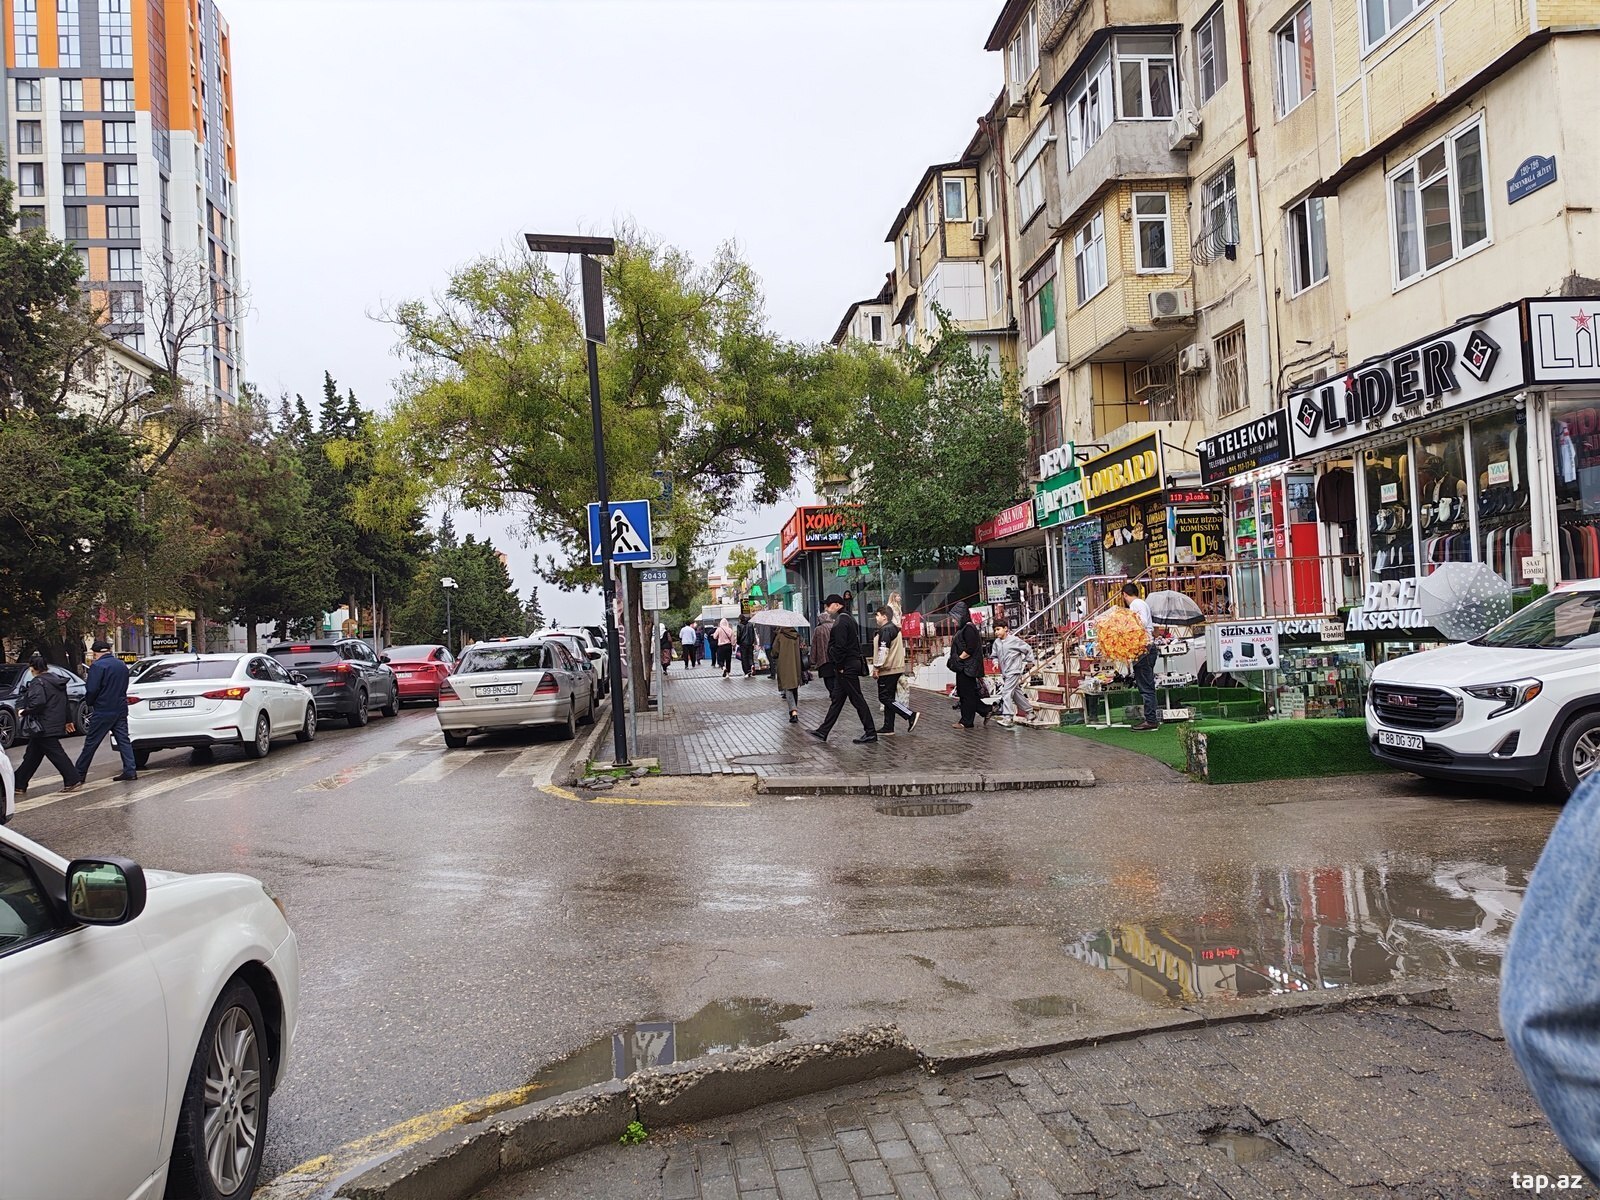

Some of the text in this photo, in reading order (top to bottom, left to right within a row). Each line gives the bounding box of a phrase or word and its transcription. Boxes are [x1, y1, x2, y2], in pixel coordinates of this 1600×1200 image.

[1538, 308, 1600, 369] Lİ
[1218, 416, 1278, 455] TELEKOM
[1040, 444, 1072, 479] DEPO
[1490, 464, 1506, 475] YAY
[1082, 450, 1157, 500] LOMBARD
[1382, 485, 1395, 495] YAY
[1185, 492, 1210, 502] plonka
[1200, 515, 1222, 523] BİZDƏ
[1180, 524, 1220, 532] KOMİSSİYA
[1191, 533, 1219, 556] 0%
[840, 558, 866, 567] APTEK
[643, 572, 667, 580] 20430
[1524, 567, 1544, 575] TƏMİRİ
[1221, 626, 1272, 636] SİZİN.SAAT
[1093, 664, 1100, 672] 5
[1388, 694, 1417, 707] GMC
[1407, 736, 1421, 749] 372
